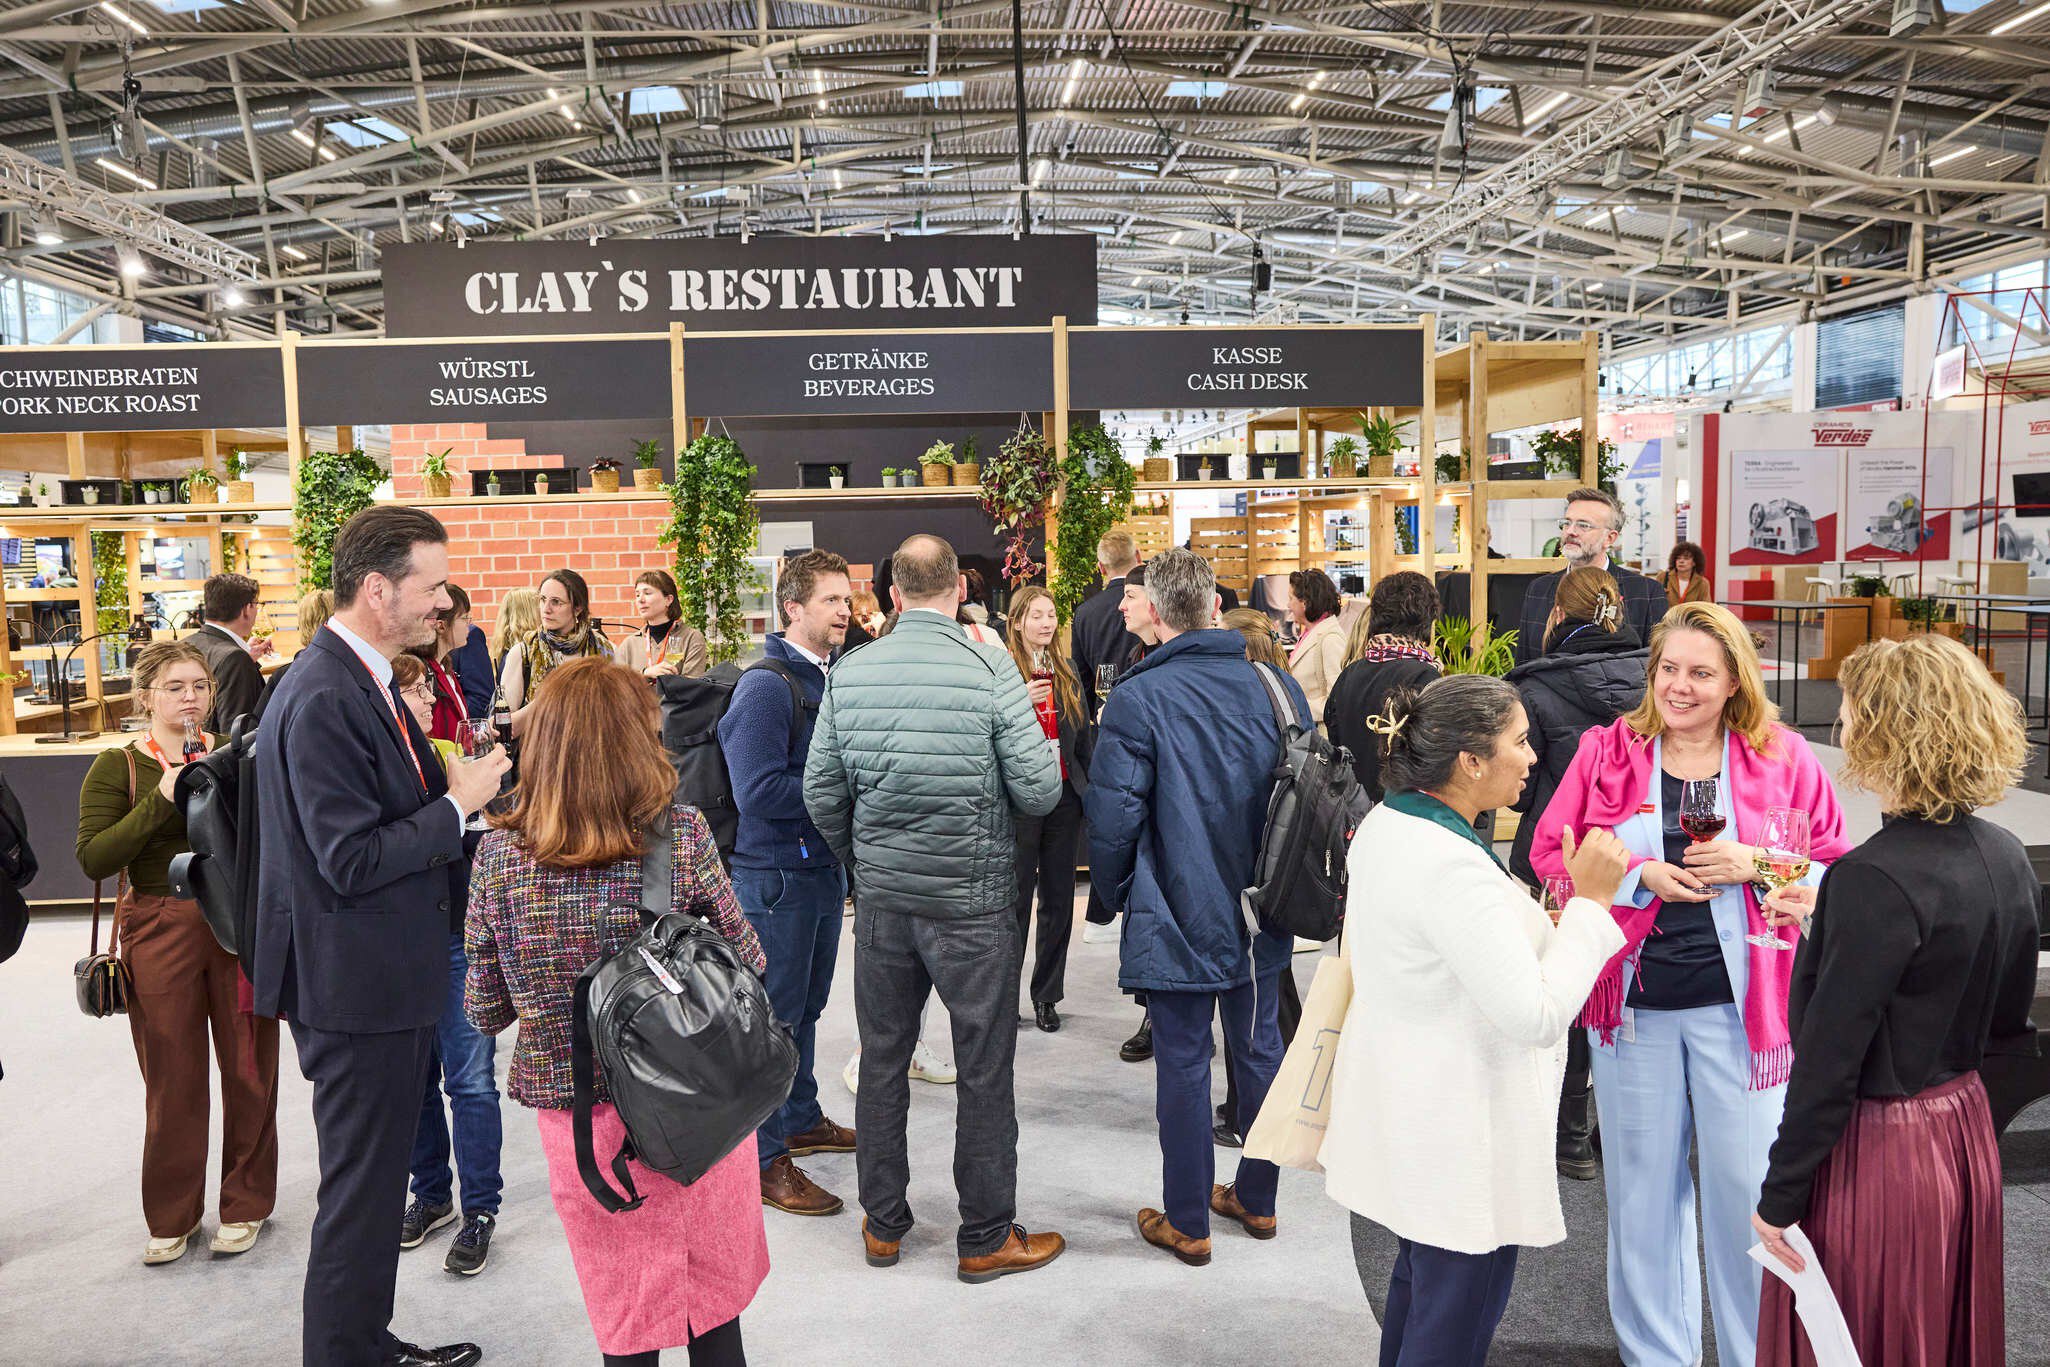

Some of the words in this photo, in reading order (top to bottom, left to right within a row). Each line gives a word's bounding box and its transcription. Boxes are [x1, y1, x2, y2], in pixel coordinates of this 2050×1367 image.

[667, 267, 1022, 311] RESTAURANT
[808, 351, 929, 371] GETRÄNKE
[1212, 347, 1283, 365] KASSE
[438, 356, 536, 379] WÜRSTL
[0, 367, 199, 389] CHWEINEBRATEN
[803, 377, 935, 397] BEVERAGES
[1187, 373, 1245, 391] CASH
[1249, 372, 1309, 390] DESK
[0, 396, 52, 416] ORK
[56, 395, 121, 414] NECK
[124, 393, 201, 413] ROAST
[429, 386, 548, 407] SAUSAGES
[1811, 429, 1873, 443] Verdés
